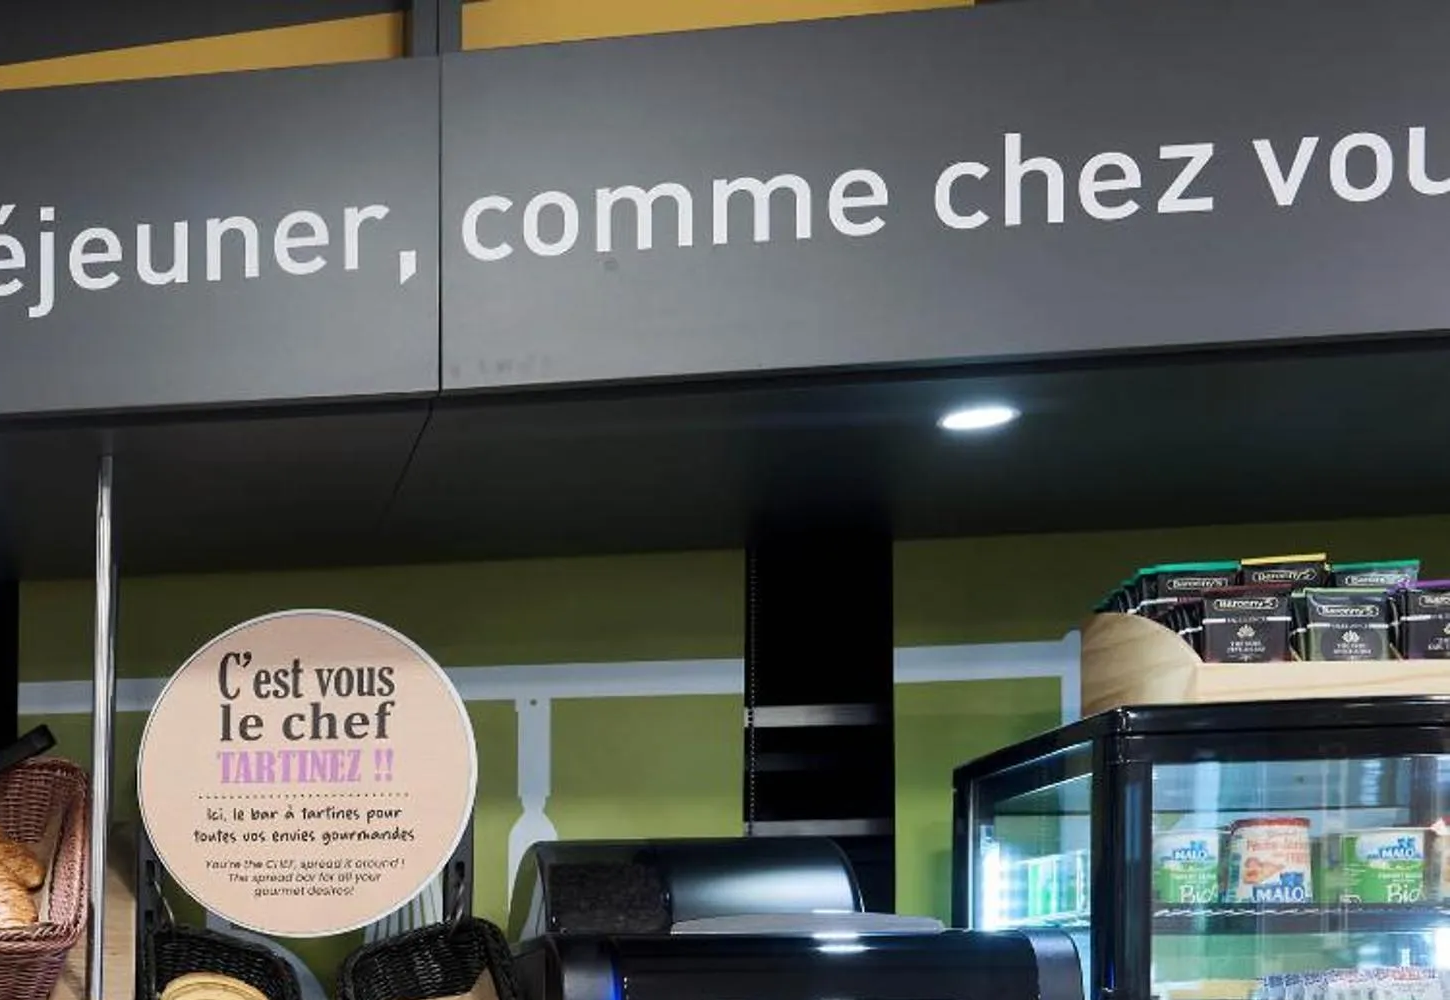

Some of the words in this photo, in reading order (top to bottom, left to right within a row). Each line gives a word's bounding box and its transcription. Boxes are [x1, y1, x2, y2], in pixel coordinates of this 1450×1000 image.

[460, 167, 890, 262] comme
[934, 132, 1216, 230] chez
[218, 651, 303, 700] C'est
[315, 665, 395, 699] vous
[219, 703, 264, 742] le
[282, 700, 396, 741] chef
[217, 749, 362, 785] TARTINEZ
[373, 748, 394, 782] !!
[233, 807, 245, 821] le
[250, 807, 279, 821] bar
[284, 804, 295, 820] à
[302, 806, 361, 820] tartines
[366, 807, 403, 824] pour
[194, 829, 237, 844] toutes
[243, 831, 266, 842] vos
[272, 828, 316, 842] envies
[321, 827, 416, 846] gourmandes
[254, 887, 305, 897] gourmet
[1256, 886, 1305, 902] MALO
[1386, 882, 1421, 904] Bio
